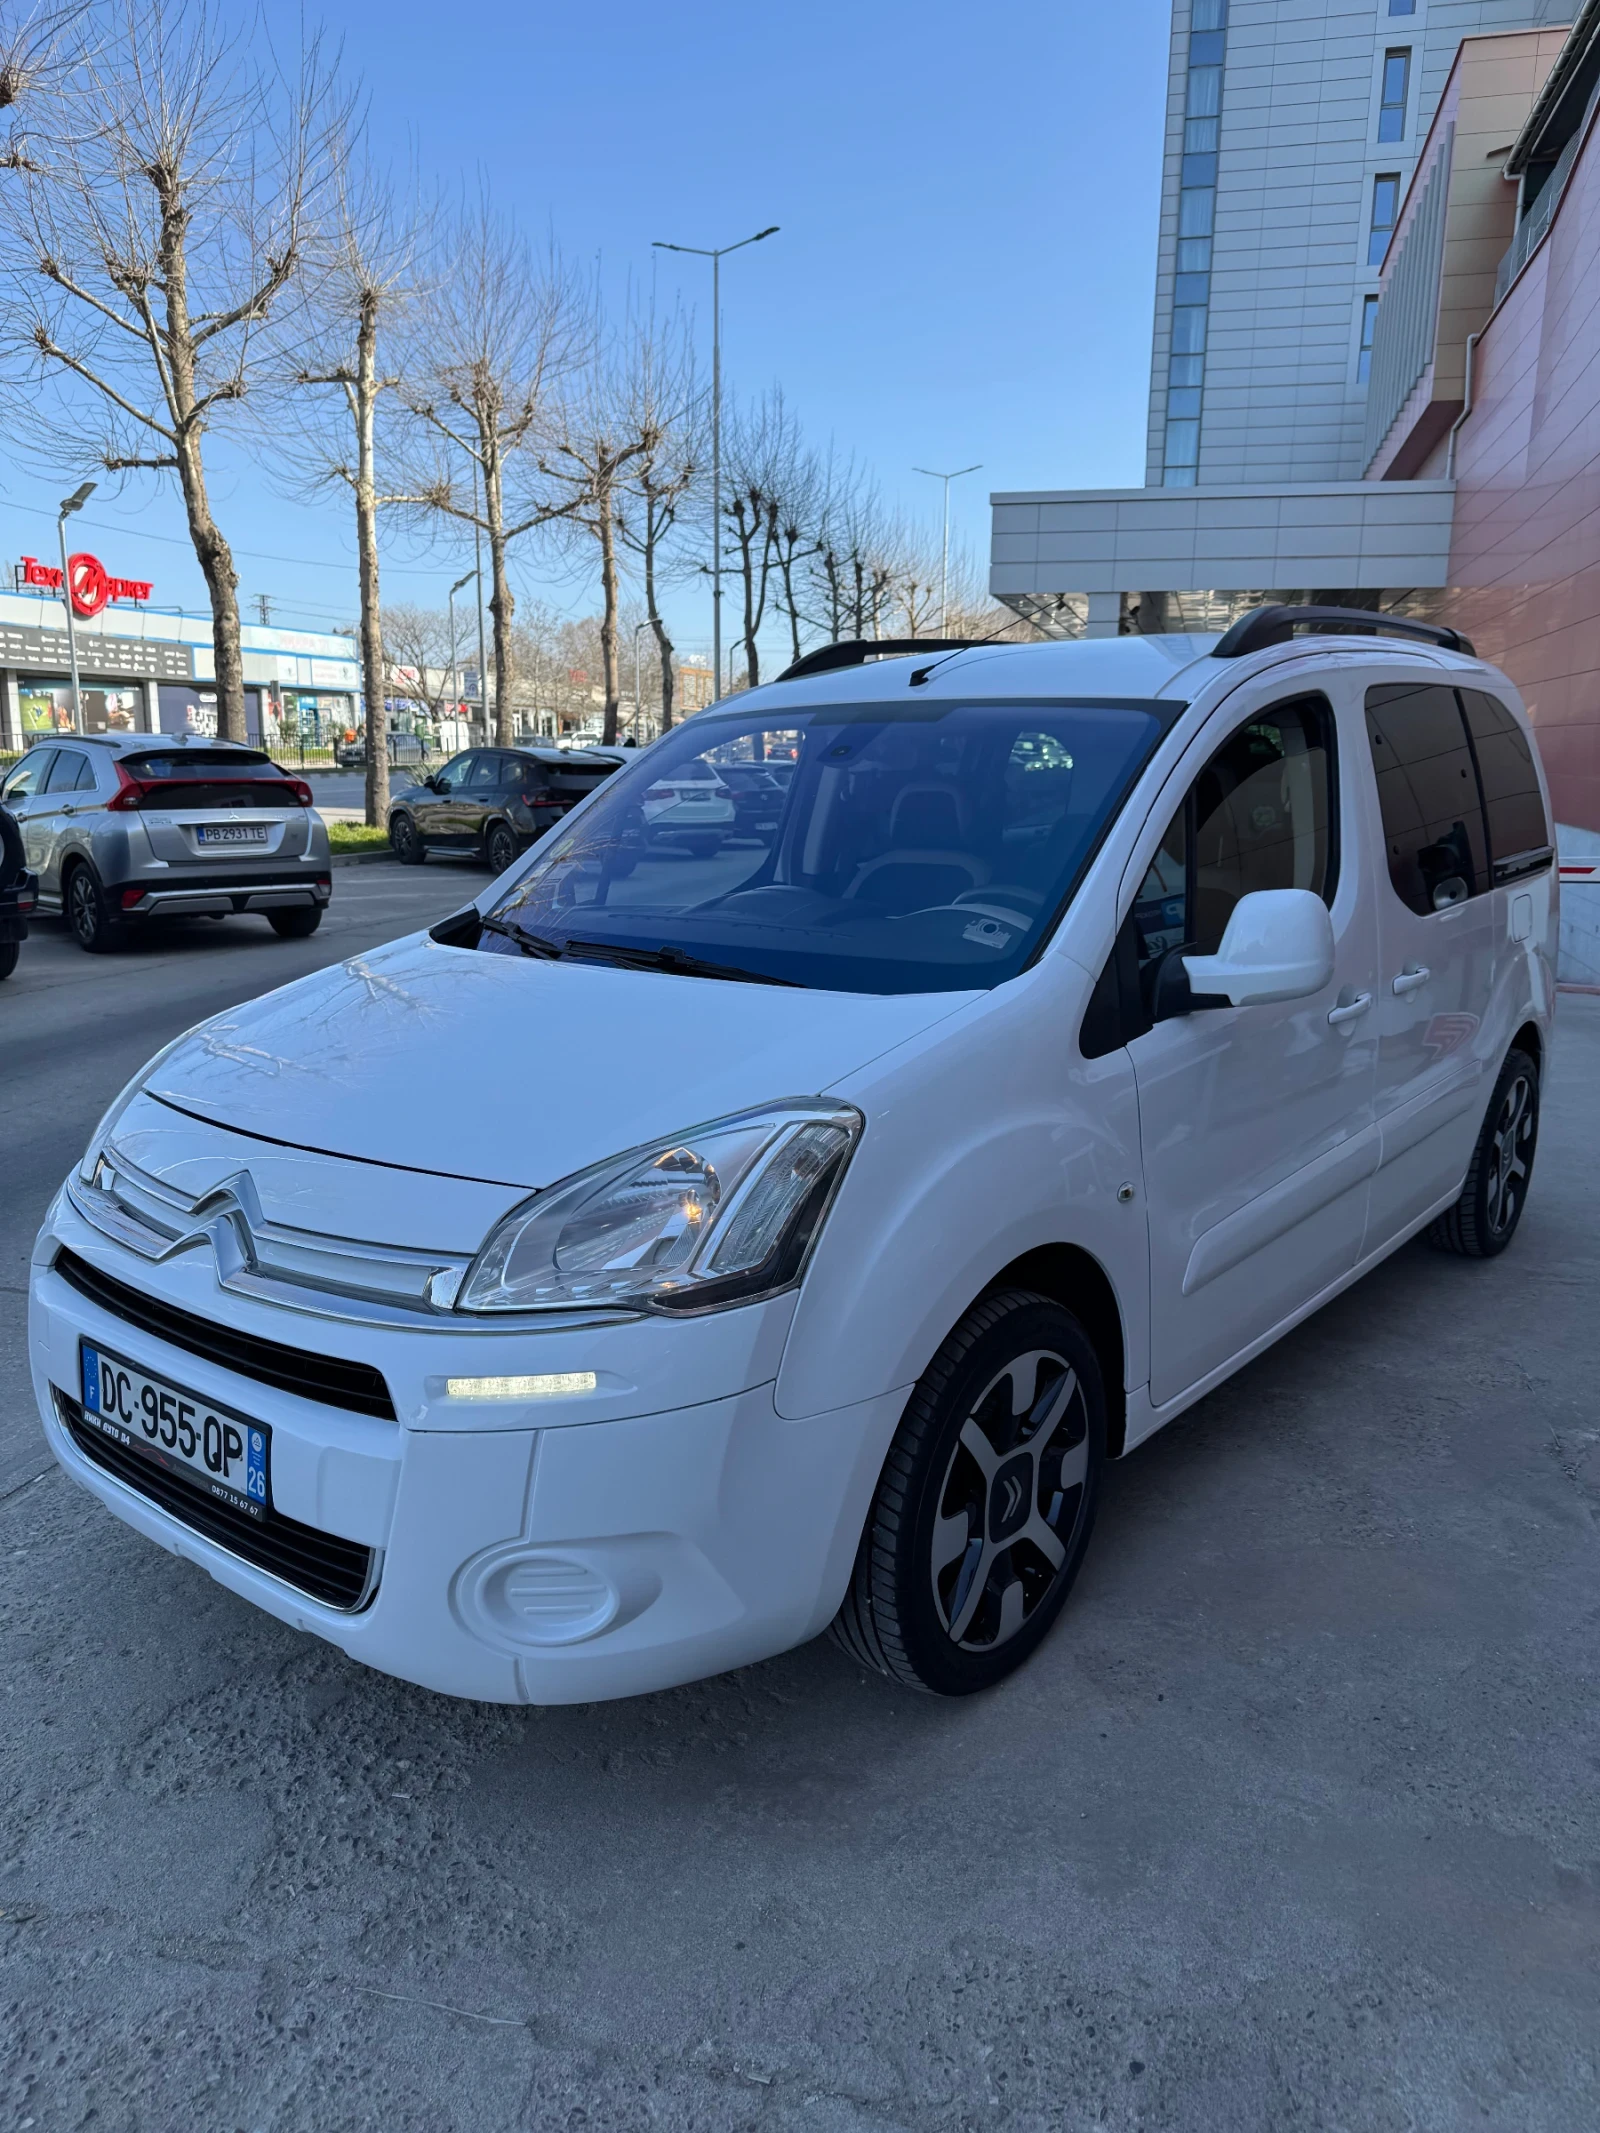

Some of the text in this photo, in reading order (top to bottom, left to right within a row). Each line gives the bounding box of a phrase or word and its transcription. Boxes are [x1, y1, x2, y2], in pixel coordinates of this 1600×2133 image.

[205, 827, 265, 840] PB 2931 TE
[89, 1385, 96, 1400] F
[101, 1361, 242, 1478] DC-955-QP
[248, 1466, 266, 1498] 26
[211, 1484, 229, 1499] 0877
[229, 1494, 238, 1505] 15
[239, 1500, 248, 1510] 67
[249, 1505, 259, 1516] 67
